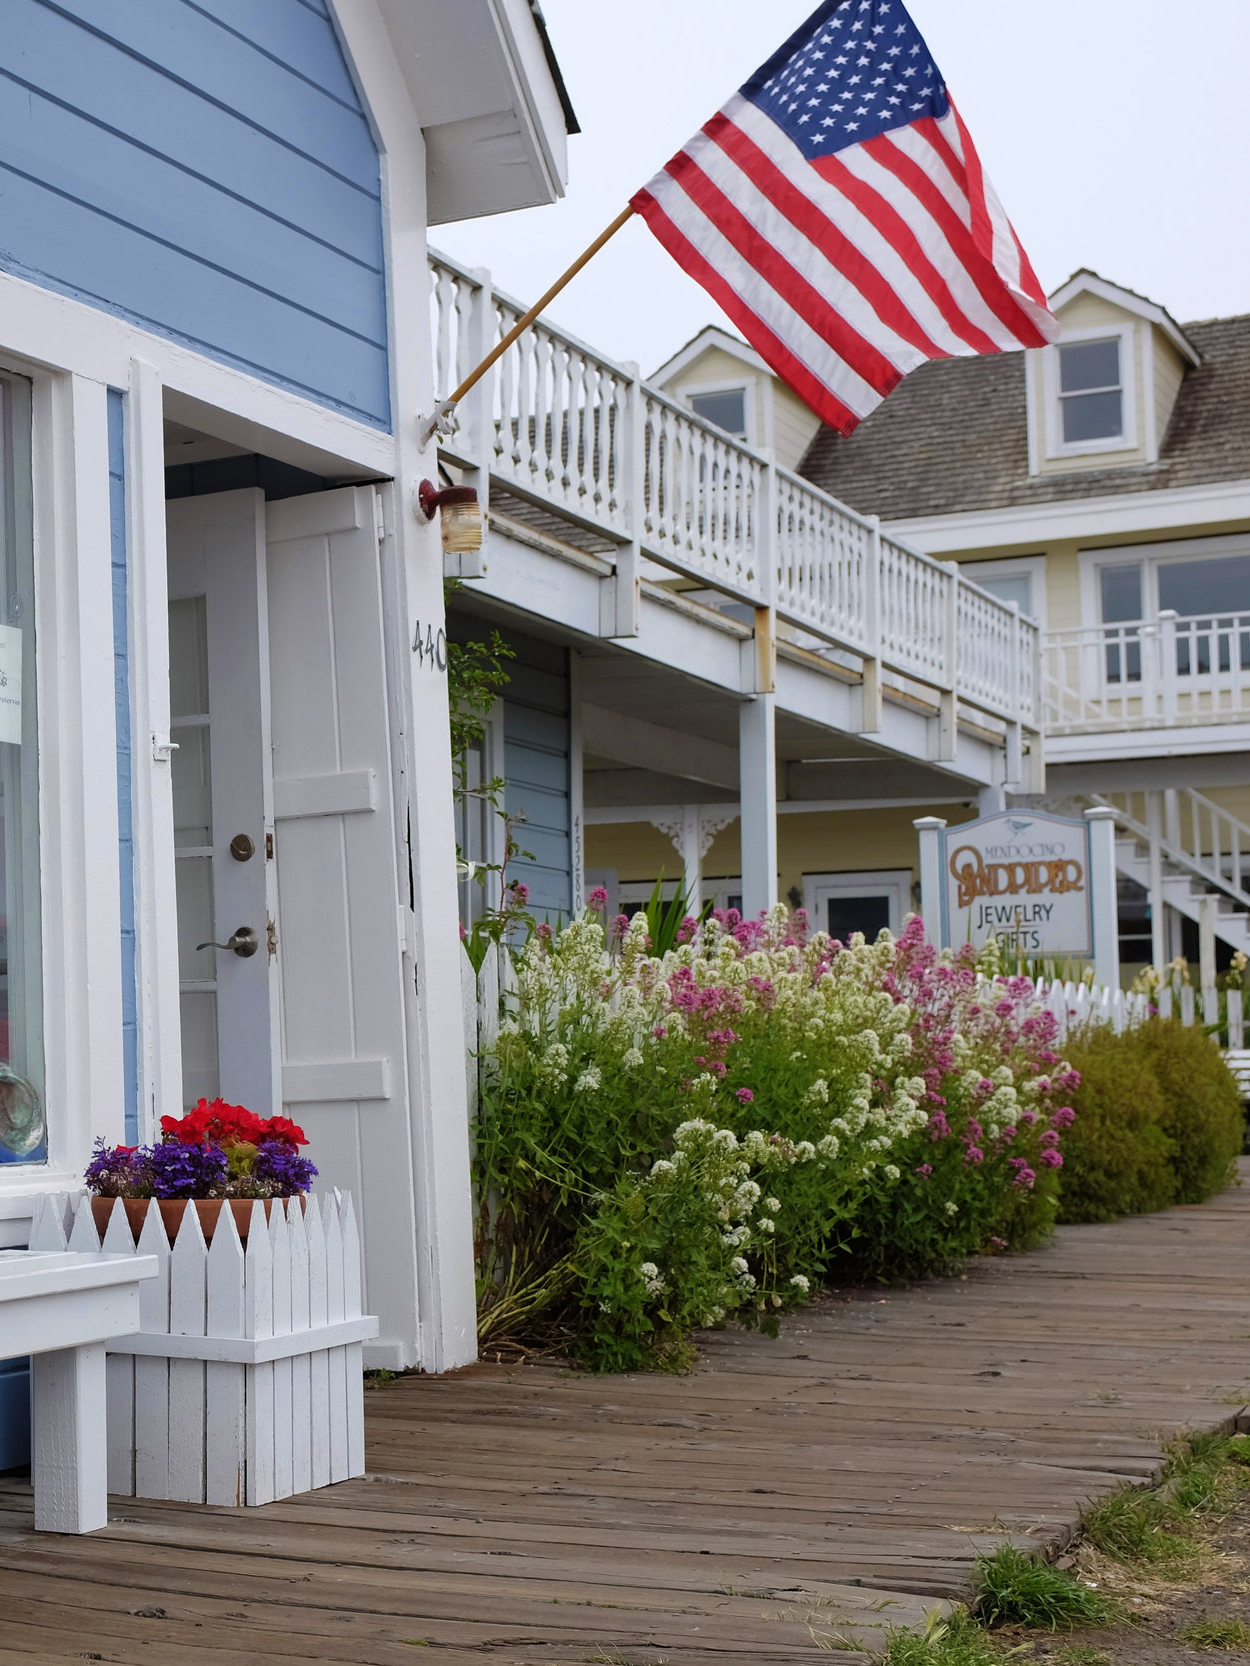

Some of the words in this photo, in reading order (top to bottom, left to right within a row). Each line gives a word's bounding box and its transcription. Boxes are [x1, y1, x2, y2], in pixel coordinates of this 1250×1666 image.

[412, 619, 447, 672] 440
[985, 842, 1066, 859] MENDOCINO
[995, 930, 1040, 949] GIFTS
